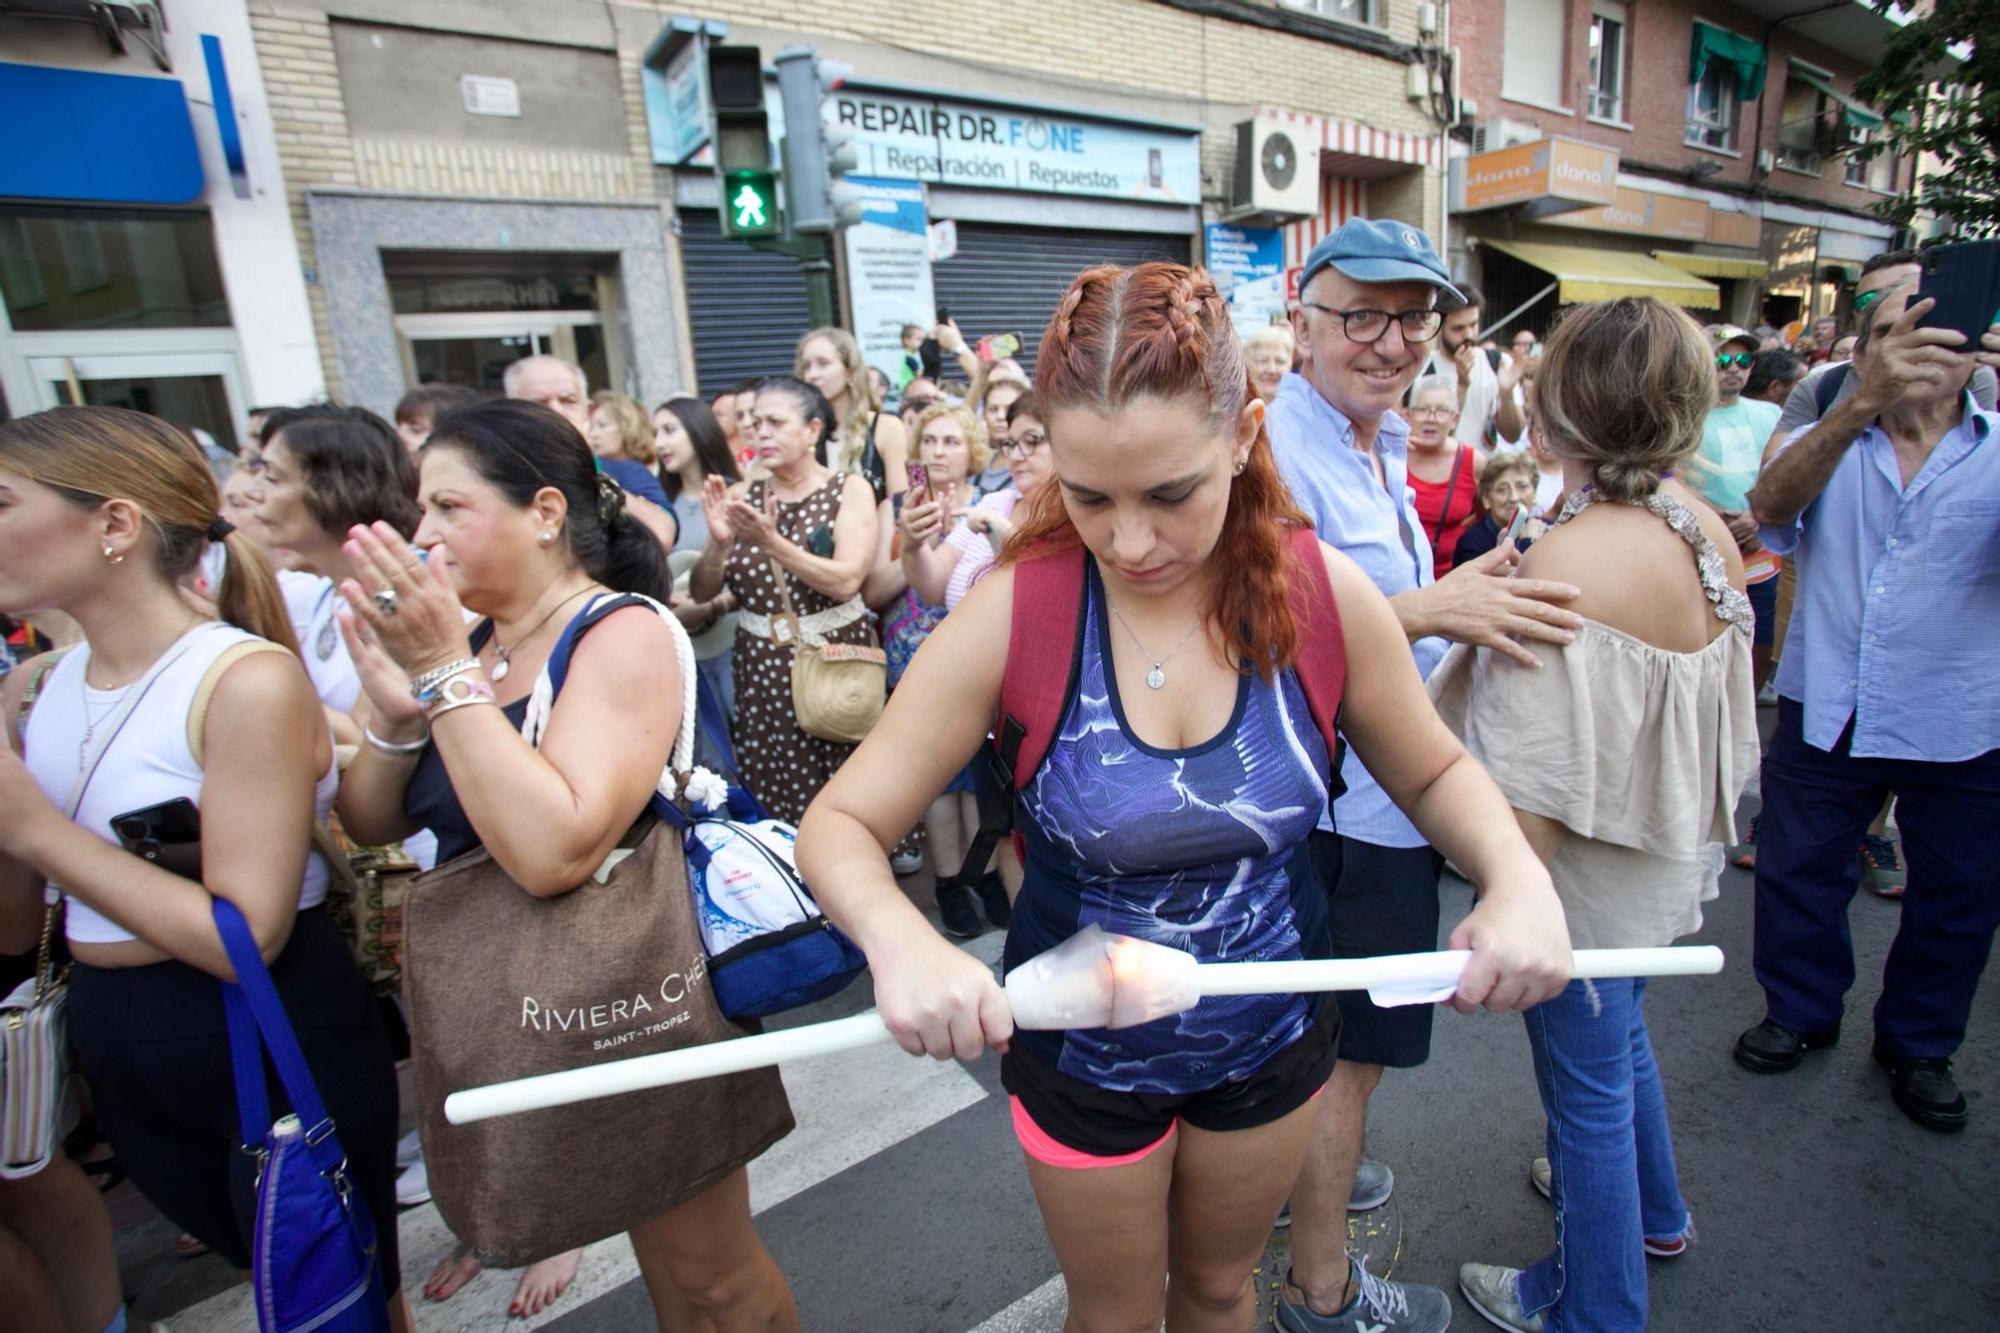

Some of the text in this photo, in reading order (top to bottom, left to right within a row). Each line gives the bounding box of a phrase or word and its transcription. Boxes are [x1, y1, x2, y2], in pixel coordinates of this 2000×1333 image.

[837, 100, 1085, 153] REPAIR DR. FONE
[887, 146, 1120, 191] Reparación Repuestos
[520, 995, 653, 1032] RIVIERA
[592, 1010, 692, 1051] SAINT-TROPEZ
